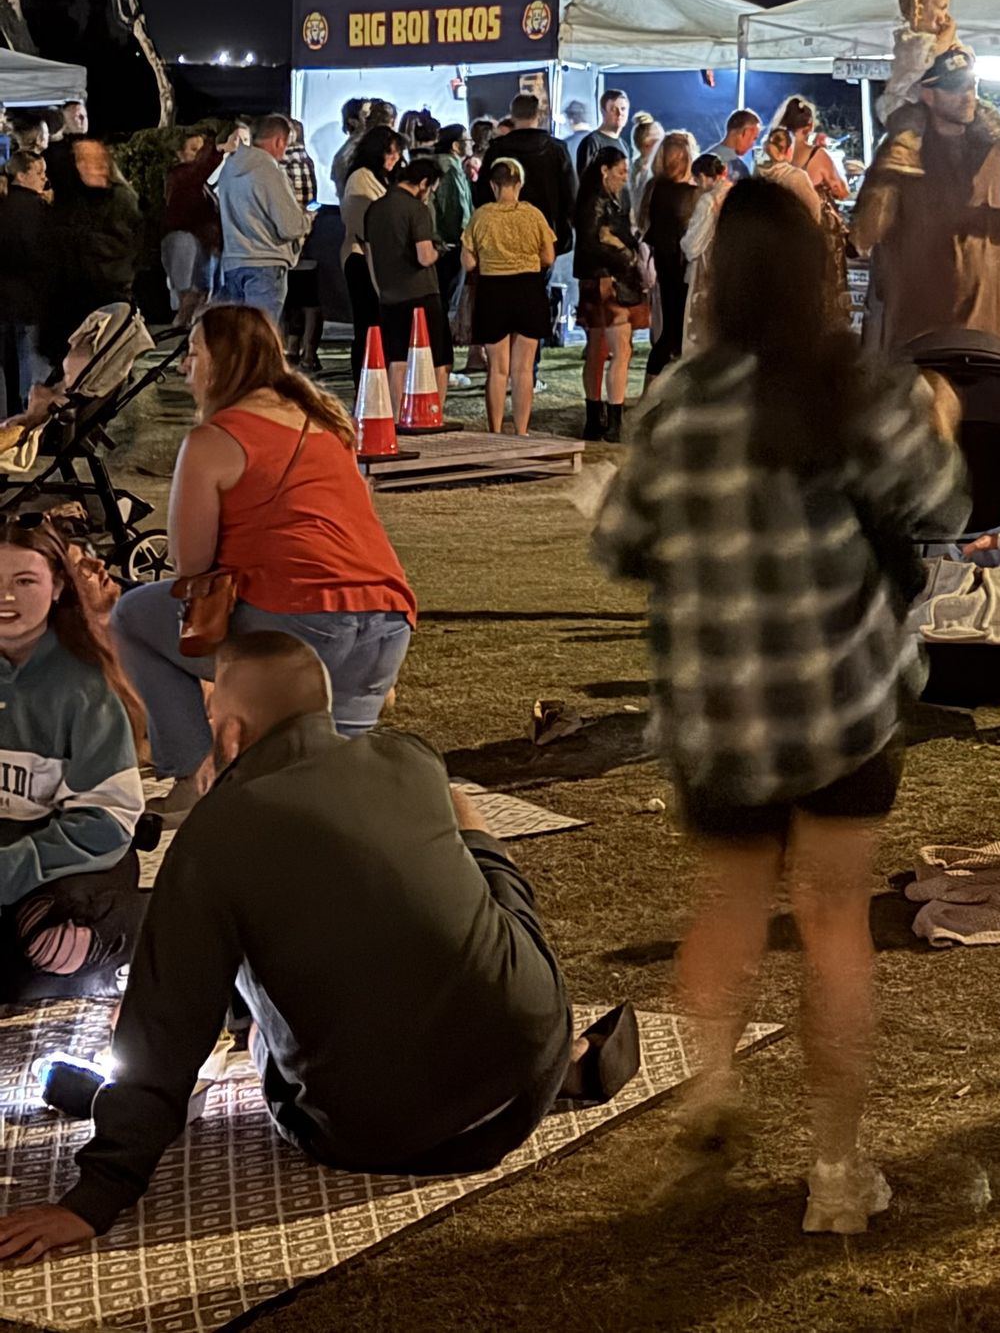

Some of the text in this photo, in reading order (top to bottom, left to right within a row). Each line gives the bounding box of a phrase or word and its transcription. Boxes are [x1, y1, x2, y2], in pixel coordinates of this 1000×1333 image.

[349, 6, 501, 47] BIG BOI TACOS
